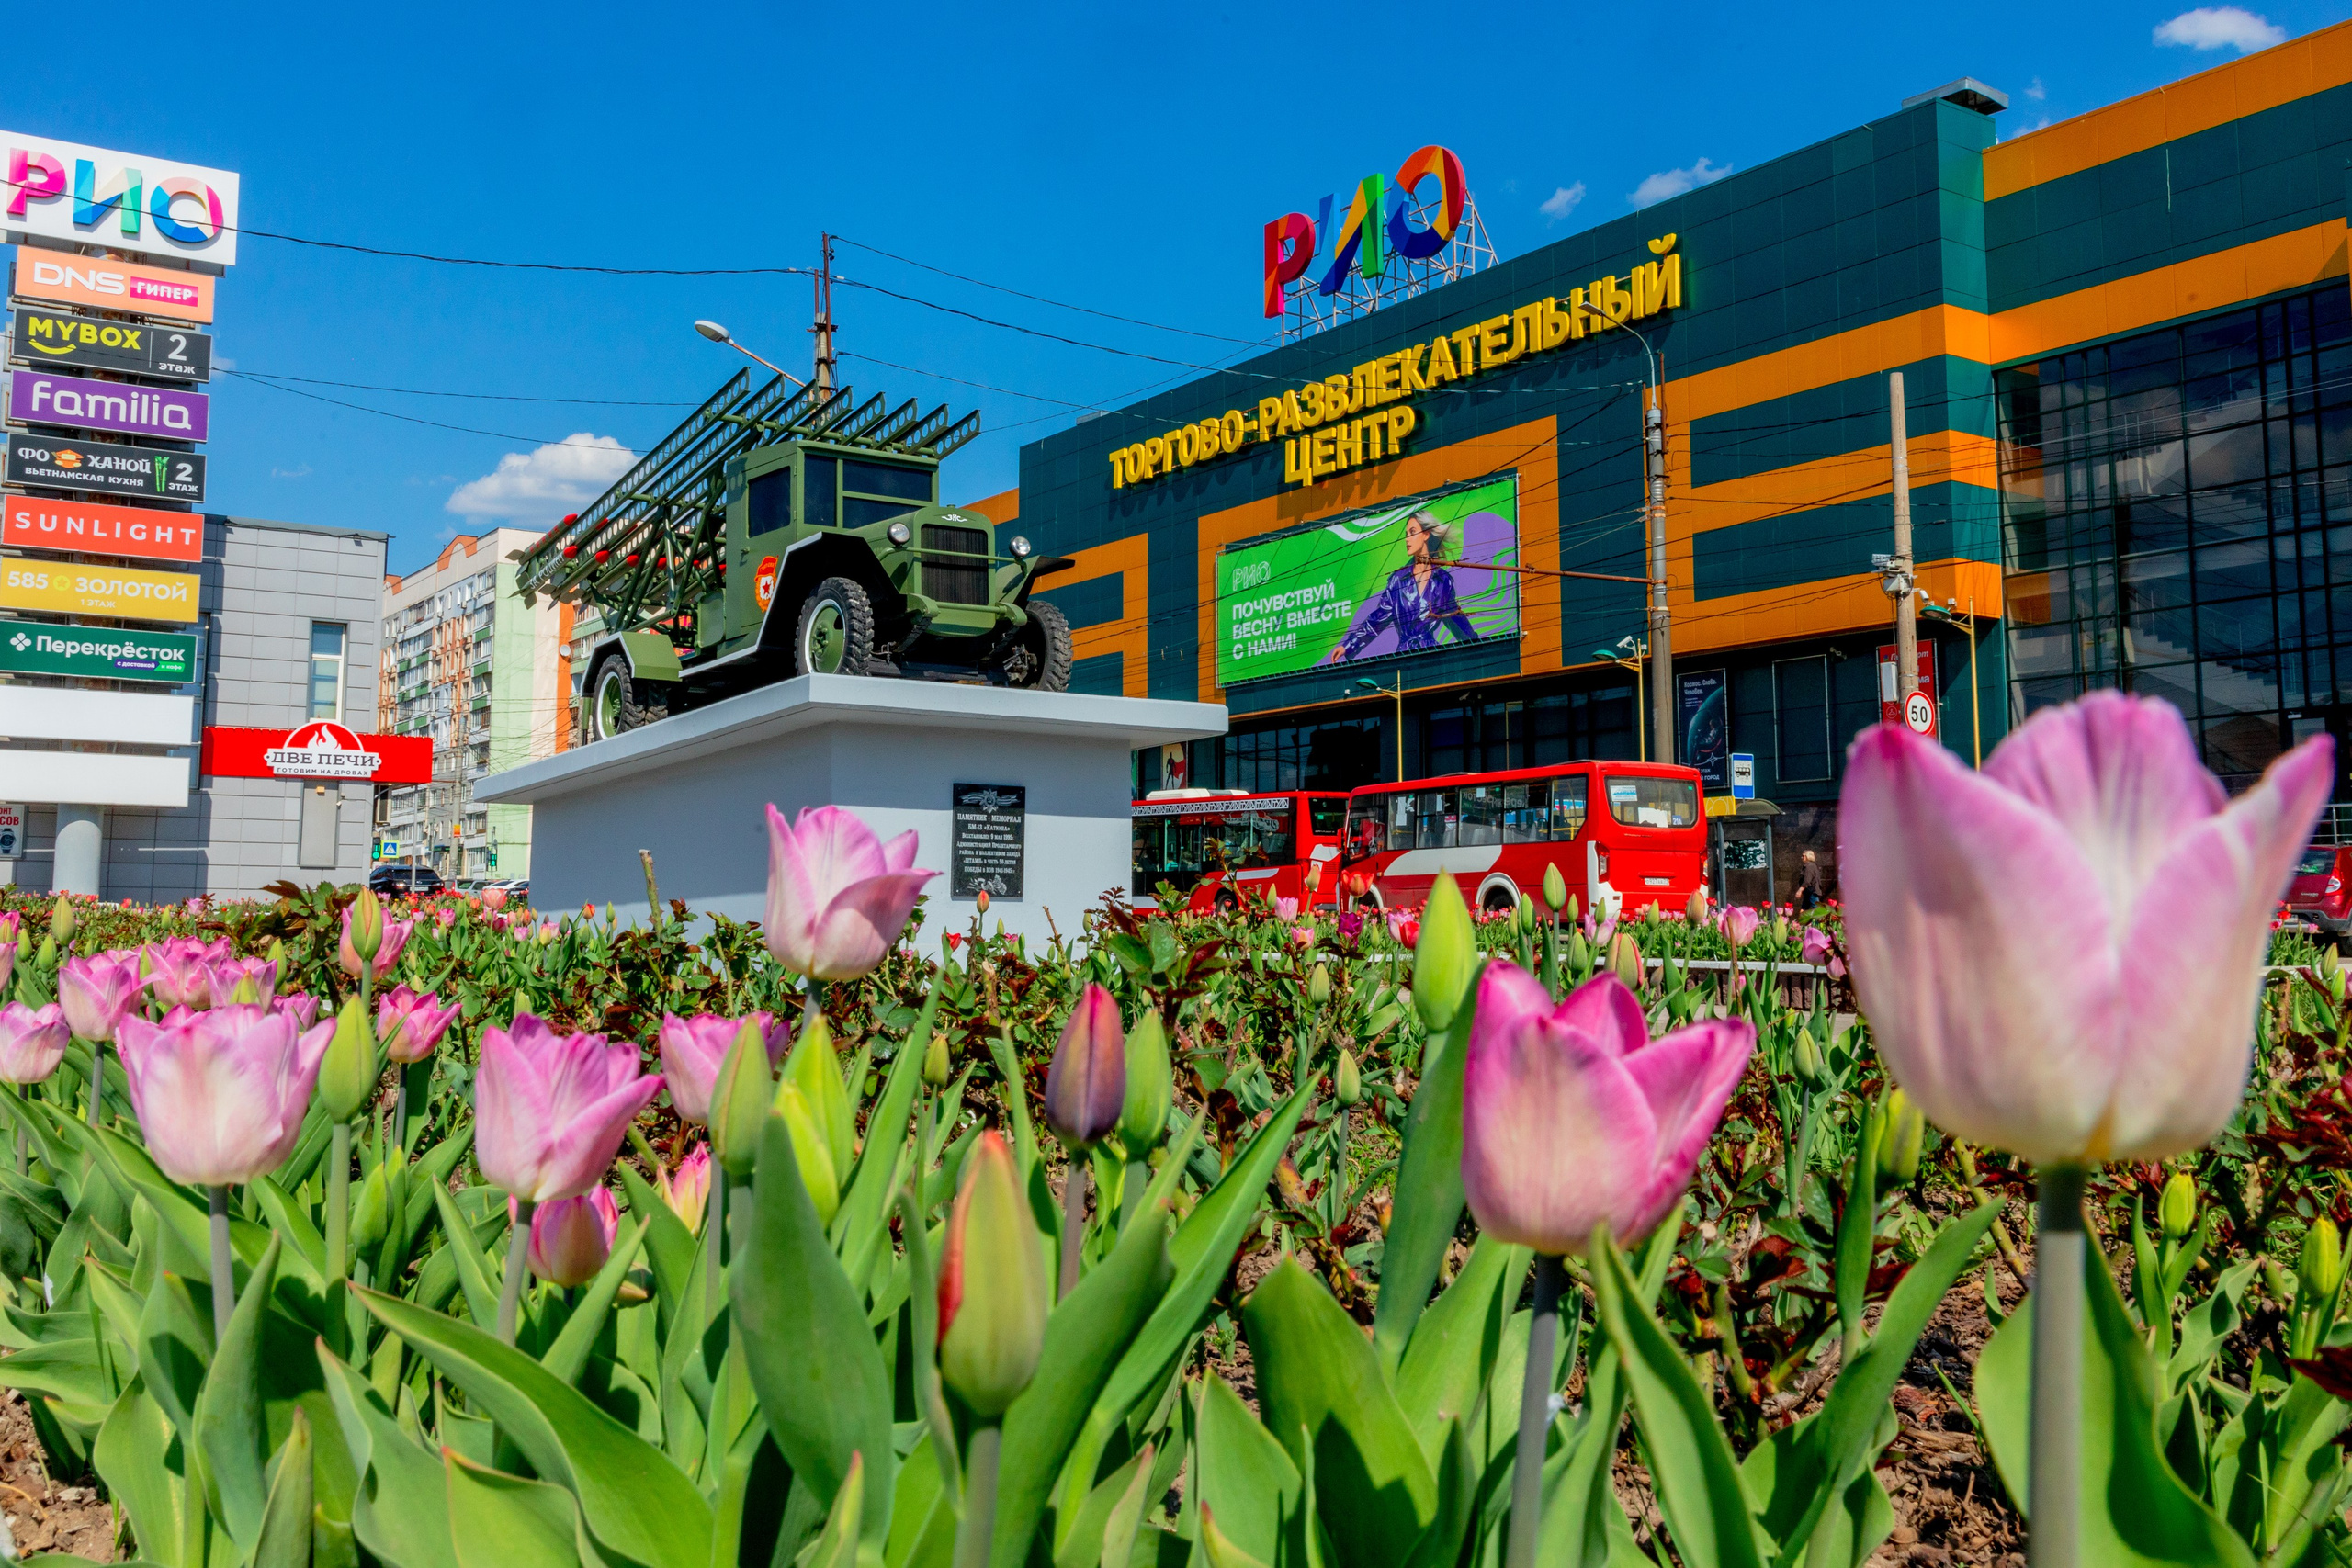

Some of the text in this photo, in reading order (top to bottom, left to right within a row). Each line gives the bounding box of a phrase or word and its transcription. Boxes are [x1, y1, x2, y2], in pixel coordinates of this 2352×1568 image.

[7, 147, 223, 243] РИО
[1263, 144, 1465, 319] РИО
[33, 261, 125, 296] DNS
[136, 281, 193, 301] ГИПЕР
[28, 316, 141, 350] MYBOX
[168, 334, 187, 360] 2
[158, 362, 195, 375] этаж
[1109, 233, 1681, 489] ТОРГОВО-РАЗВЛЕКАТЕЛЬНЫЙ
[17, 447, 152, 474] ФО ХАНОЙ
[1285, 406, 1415, 487] ЦЕНТР
[25, 467, 143, 487] ВЬЕТНАМСКАЯ КУХНЯ
[175, 463, 193, 481] 2
[168, 481, 198, 493] ЭТАЖ
[15, 512, 196, 546] SUNLIGHT
[7, 571, 187, 602] 585 ЗОЛОТОЙ
[1232, 560, 1272, 592] РИО
[86, 599, 116, 608] ЭТАЖ
[1232, 579, 1335, 621] ПОЧУВСТВУЙ
[1232, 599, 1351, 640] ВЕСНУ ВМЕСТЕ
[36, 635, 186, 661] Перекрёсток
[1232, 632, 1297, 660] С НАМИ!
[1911, 705, 1928, 723] 50
[271, 751, 375, 766] ДВЕ ПЕЧИ
